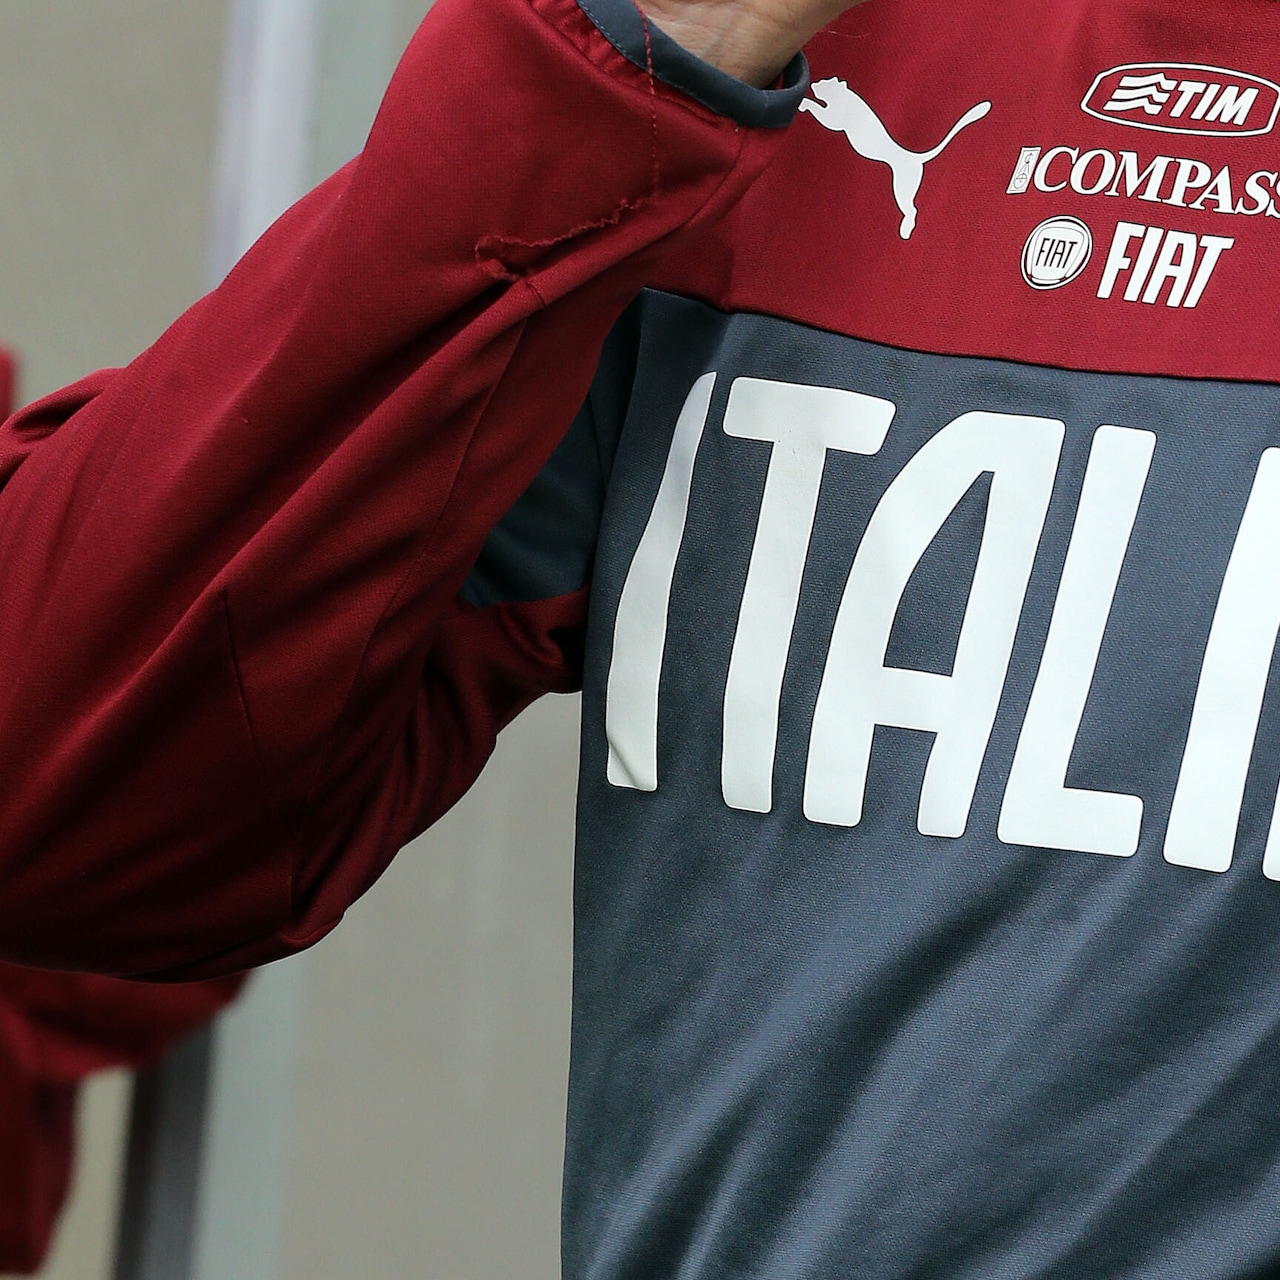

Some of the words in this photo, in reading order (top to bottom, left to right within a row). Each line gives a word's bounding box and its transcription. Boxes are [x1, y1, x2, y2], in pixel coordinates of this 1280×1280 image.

[1169, 80, 1260, 126] TIM
[1035, 237, 1078, 269] FIAT
[1096, 221, 1235, 308] FIAT
